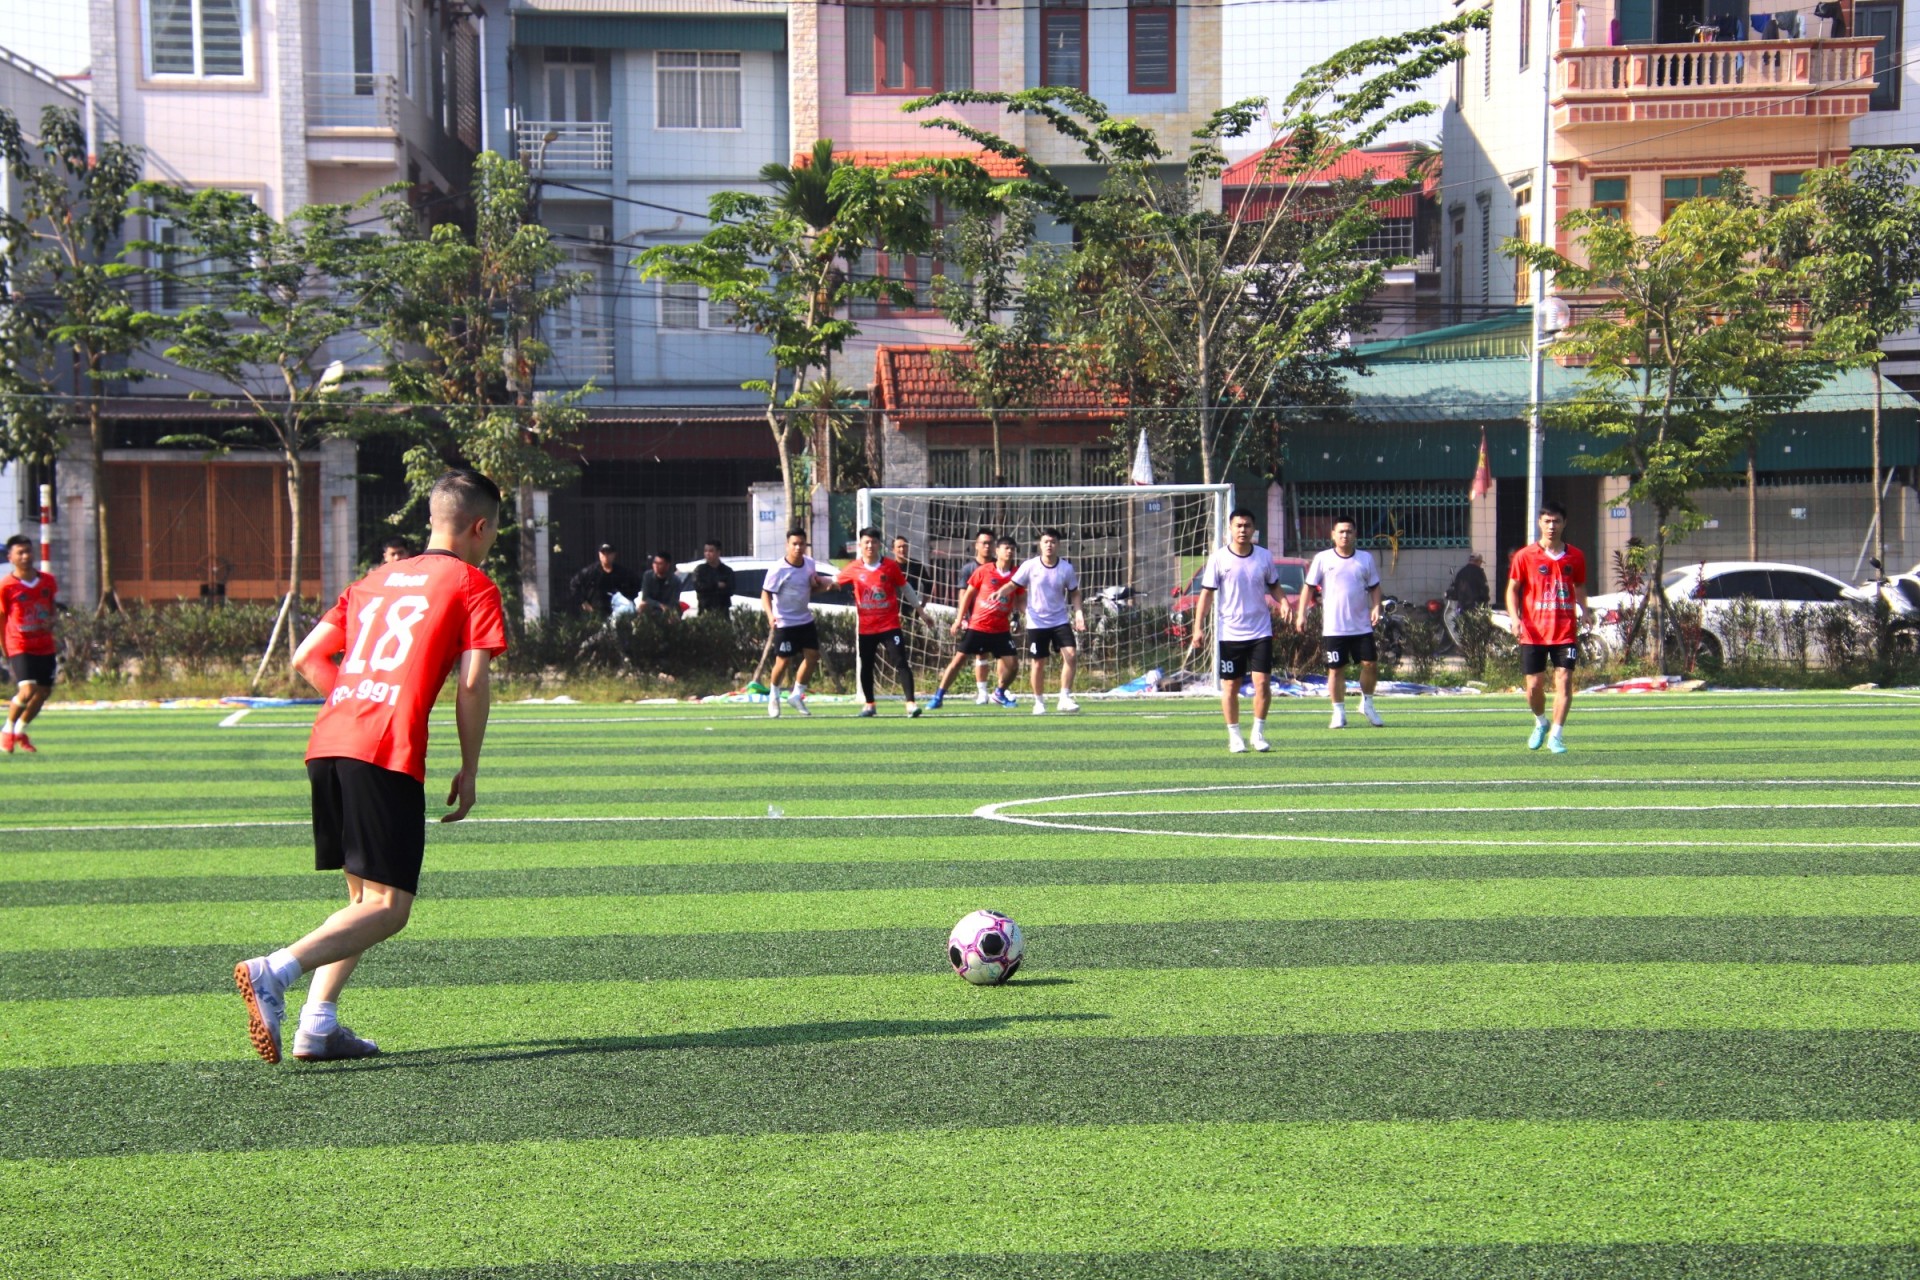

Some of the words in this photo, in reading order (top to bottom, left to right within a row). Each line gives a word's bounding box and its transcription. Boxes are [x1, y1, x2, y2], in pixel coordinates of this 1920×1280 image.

[1613, 509, 1626, 517] 100
[345, 595, 429, 673] 18
[893, 635, 900, 645] 9
[1030, 642, 1037, 655] 4
[1566, 647, 1577, 659] 10
